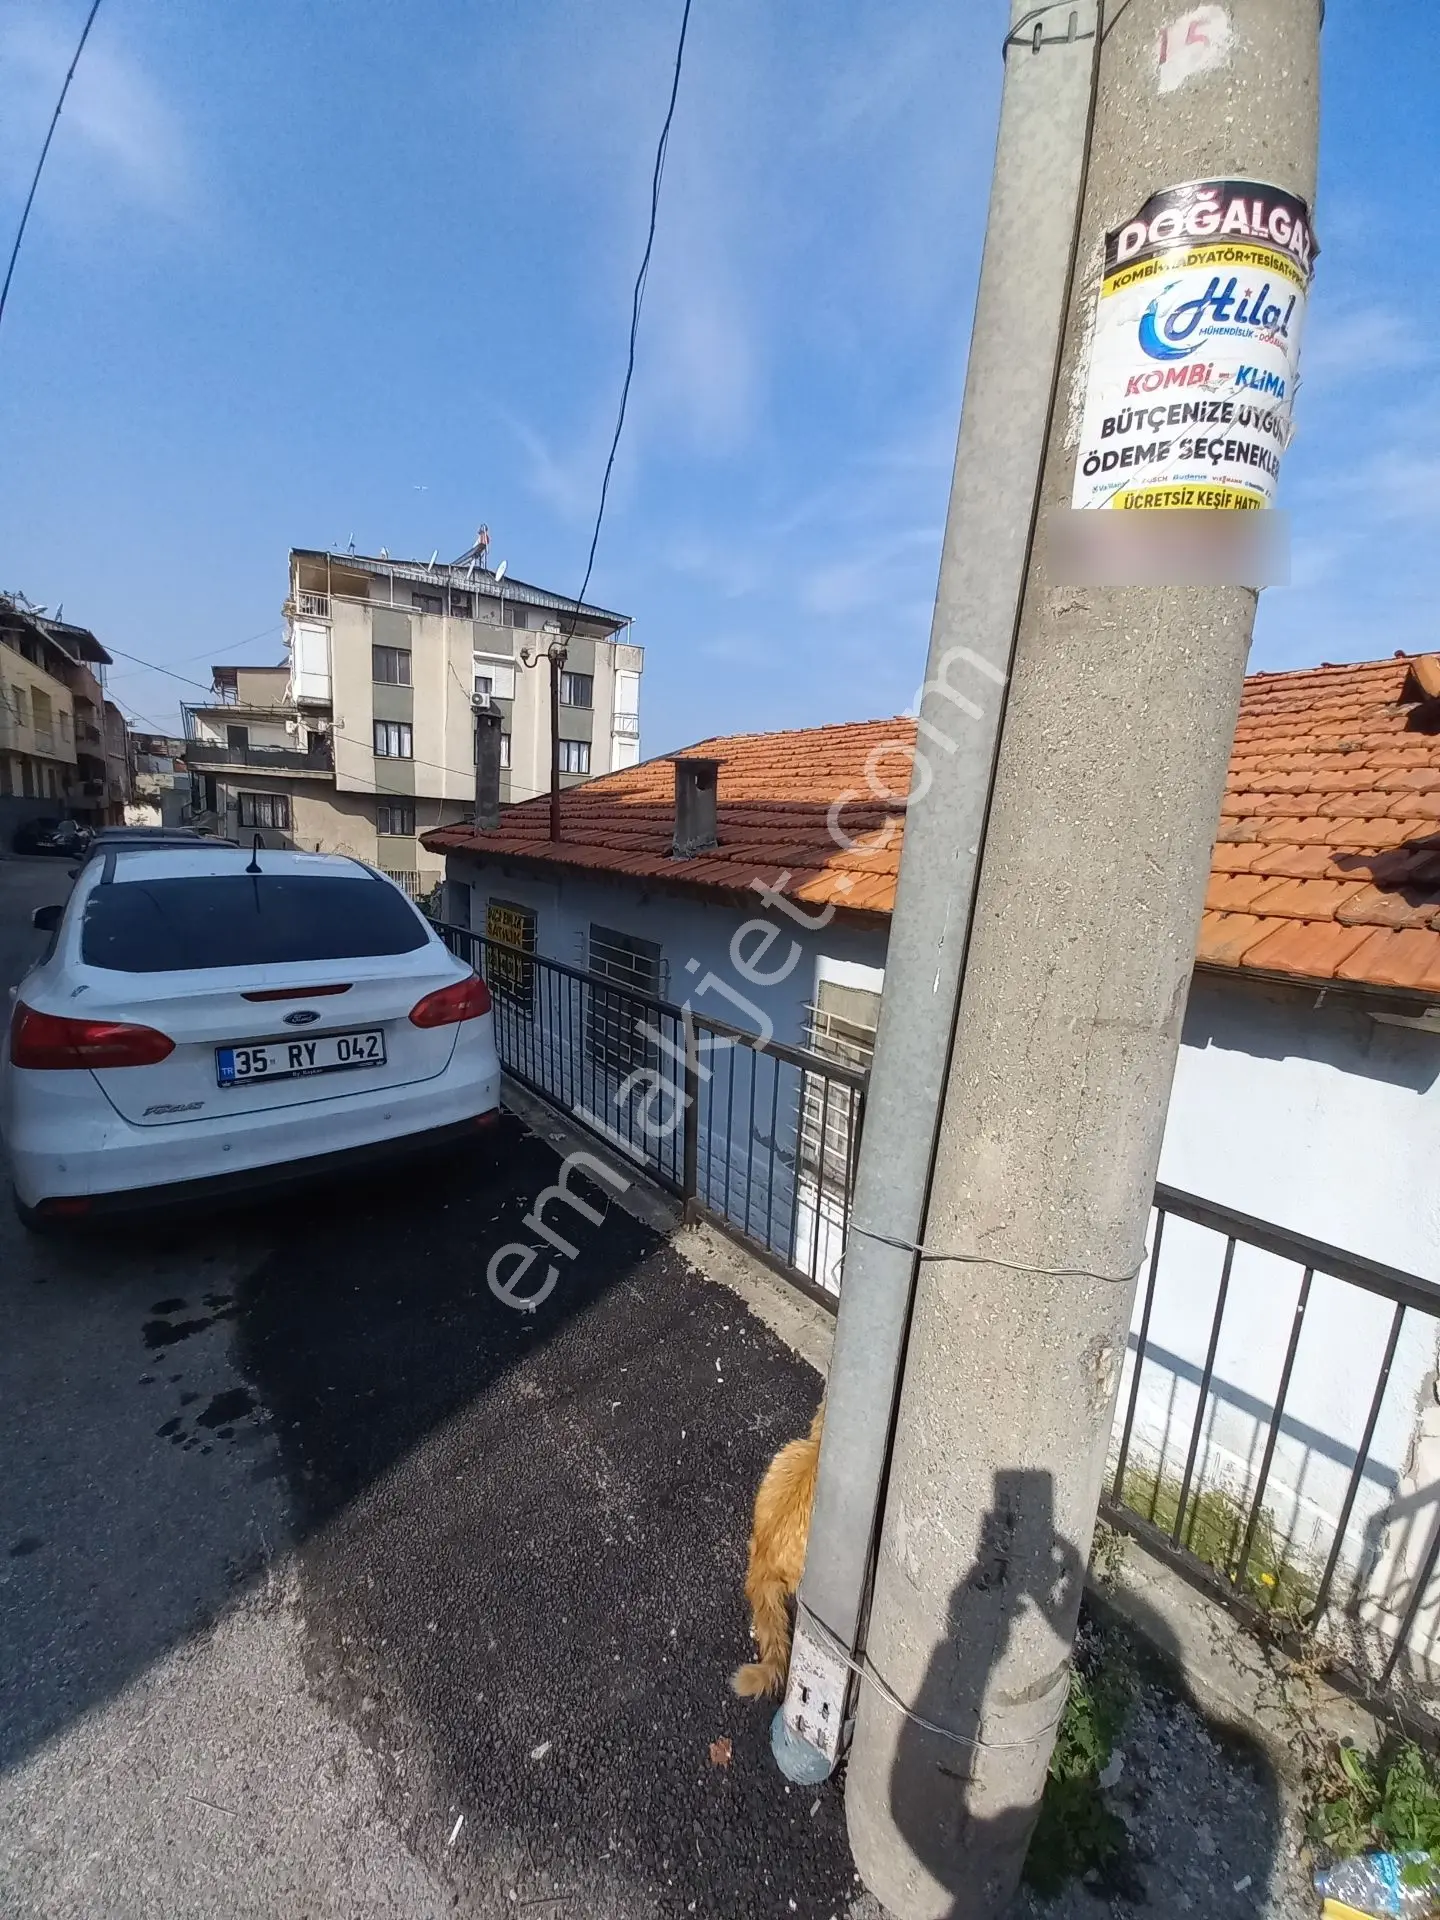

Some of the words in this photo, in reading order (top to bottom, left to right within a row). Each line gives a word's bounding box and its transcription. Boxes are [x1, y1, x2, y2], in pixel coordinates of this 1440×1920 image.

[1163, 276, 1296, 342] Hilal
[1083, 440, 1171, 477] ÖDEME
[1124, 487, 1194, 509] ÜCRETSİZ
[1197, 488, 1231, 509] KEŞİF
[221, 1066, 234, 1076] TR
[236, 1049, 269, 1075] 35
[288, 1042, 317, 1069] RY
[337, 1035, 379, 1062] 042
